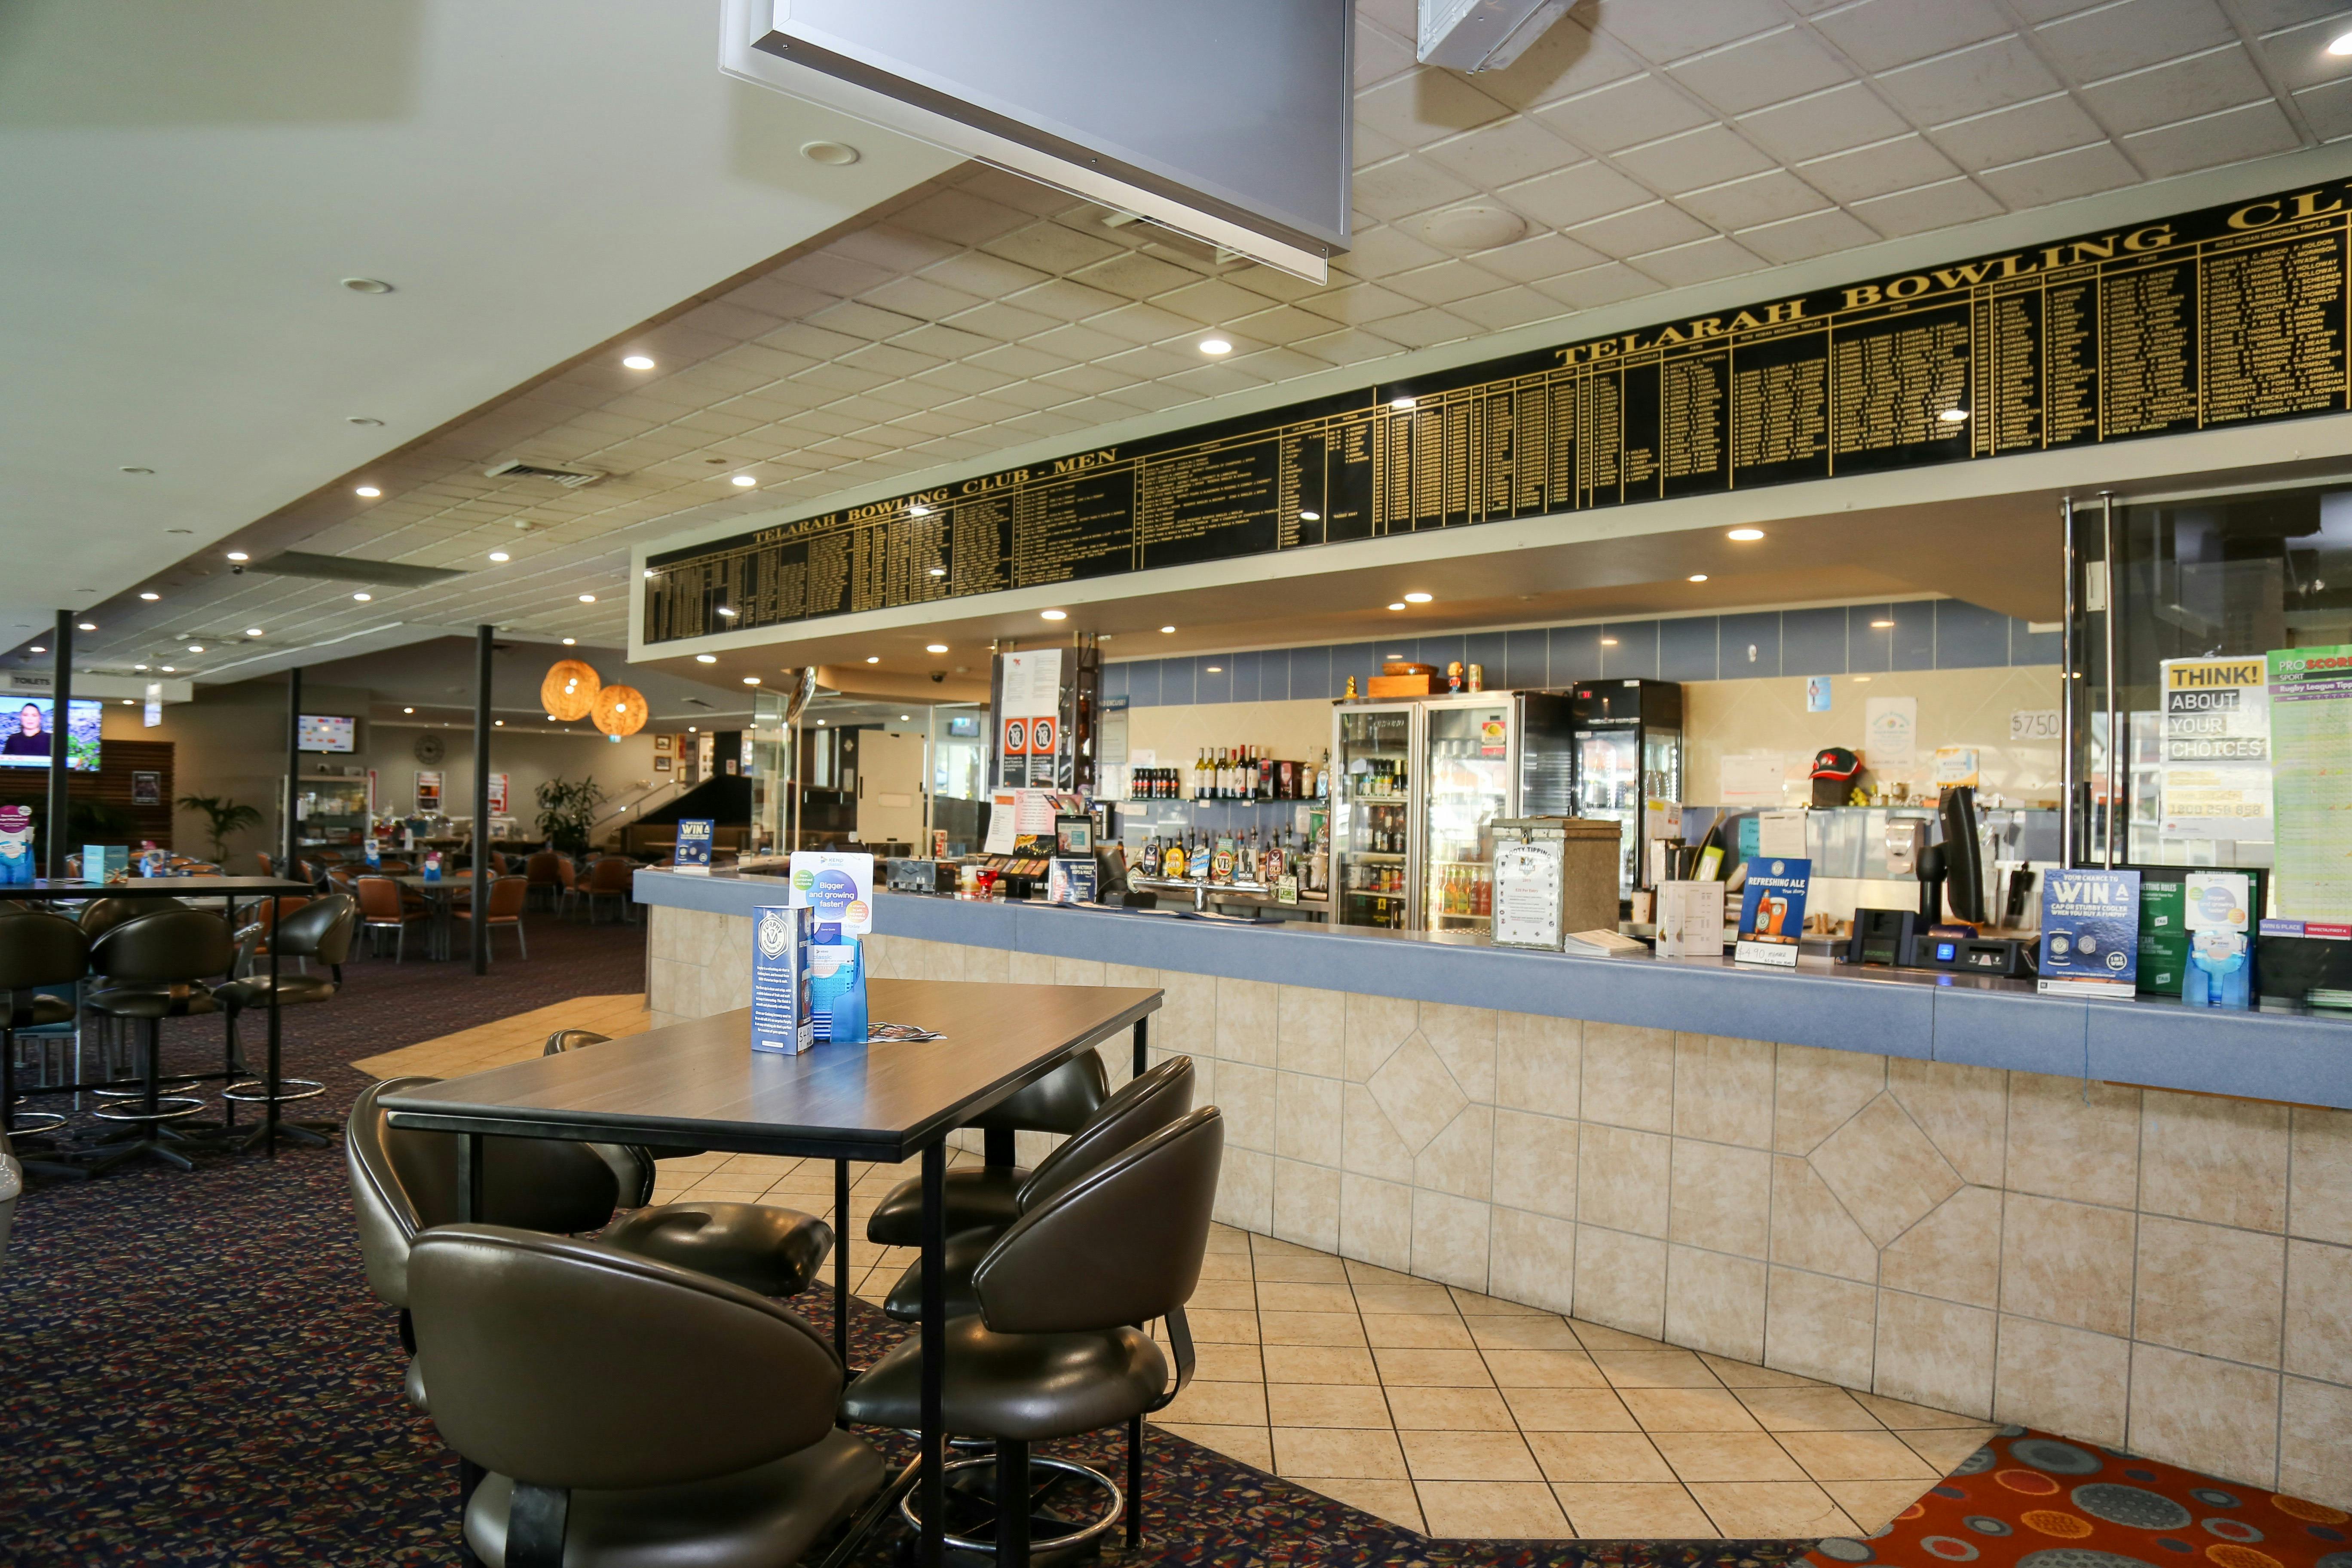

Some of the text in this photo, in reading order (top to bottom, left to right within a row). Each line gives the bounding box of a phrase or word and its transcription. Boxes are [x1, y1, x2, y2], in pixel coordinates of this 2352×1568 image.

[2301, 220, 2331, 231] TRIPLES
[1556, 184, 2352, 366] TELARAH BOWLING CL
[2309, 371, 2344, 381] SHEEHAN
[2212, 391, 2256, 401] THREADGATE
[2309, 378, 2344, 388] SHEEHAN
[2209, 399, 2246, 408] STONEMAN
[2255, 391, 2303, 403] STRICKLETON
[2314, 386, 2346, 394] GOWARD
[2251, 401, 2284, 410] PARSONS
[2296, 395, 2330, 404] SHEEHAN
[2212, 413, 2248, 422] SHEWRING
[2259, 407, 2290, 416] AURISCH
[2301, 401, 2330, 410] WHYBIN
[753, 514, 836, 542] TELARAH
[848, 487, 949, 521] BOWLING
[962, 469, 1029, 493] CLUB
[1054, 448, 1118, 474] MEN
[13, 677, 51, 685] TOILETS
[2173, 666, 2257, 686] THINK!
[2280, 685, 2304, 693] Rugby
[2171, 692, 2236, 710] ABOUT
[2171, 717, 2223, 733] YOUR
[1011, 732, 1021, 745] 18
[1038, 731, 1048, 744] 18
[2172, 740, 2261, 757] CHOICES
[2171, 805, 2202, 814] 1800
[681, 824, 703, 834] WIN
[1505, 847, 1552, 859] FOOTY TIPPING
[1217, 858, 1230, 869] VB
[820, 882, 845, 890] Bigger
[1748, 877, 1805, 888] REFRESHING ALE
[2052, 881, 2128, 904] WIN A
[763, 922, 782, 934] FURPHY
